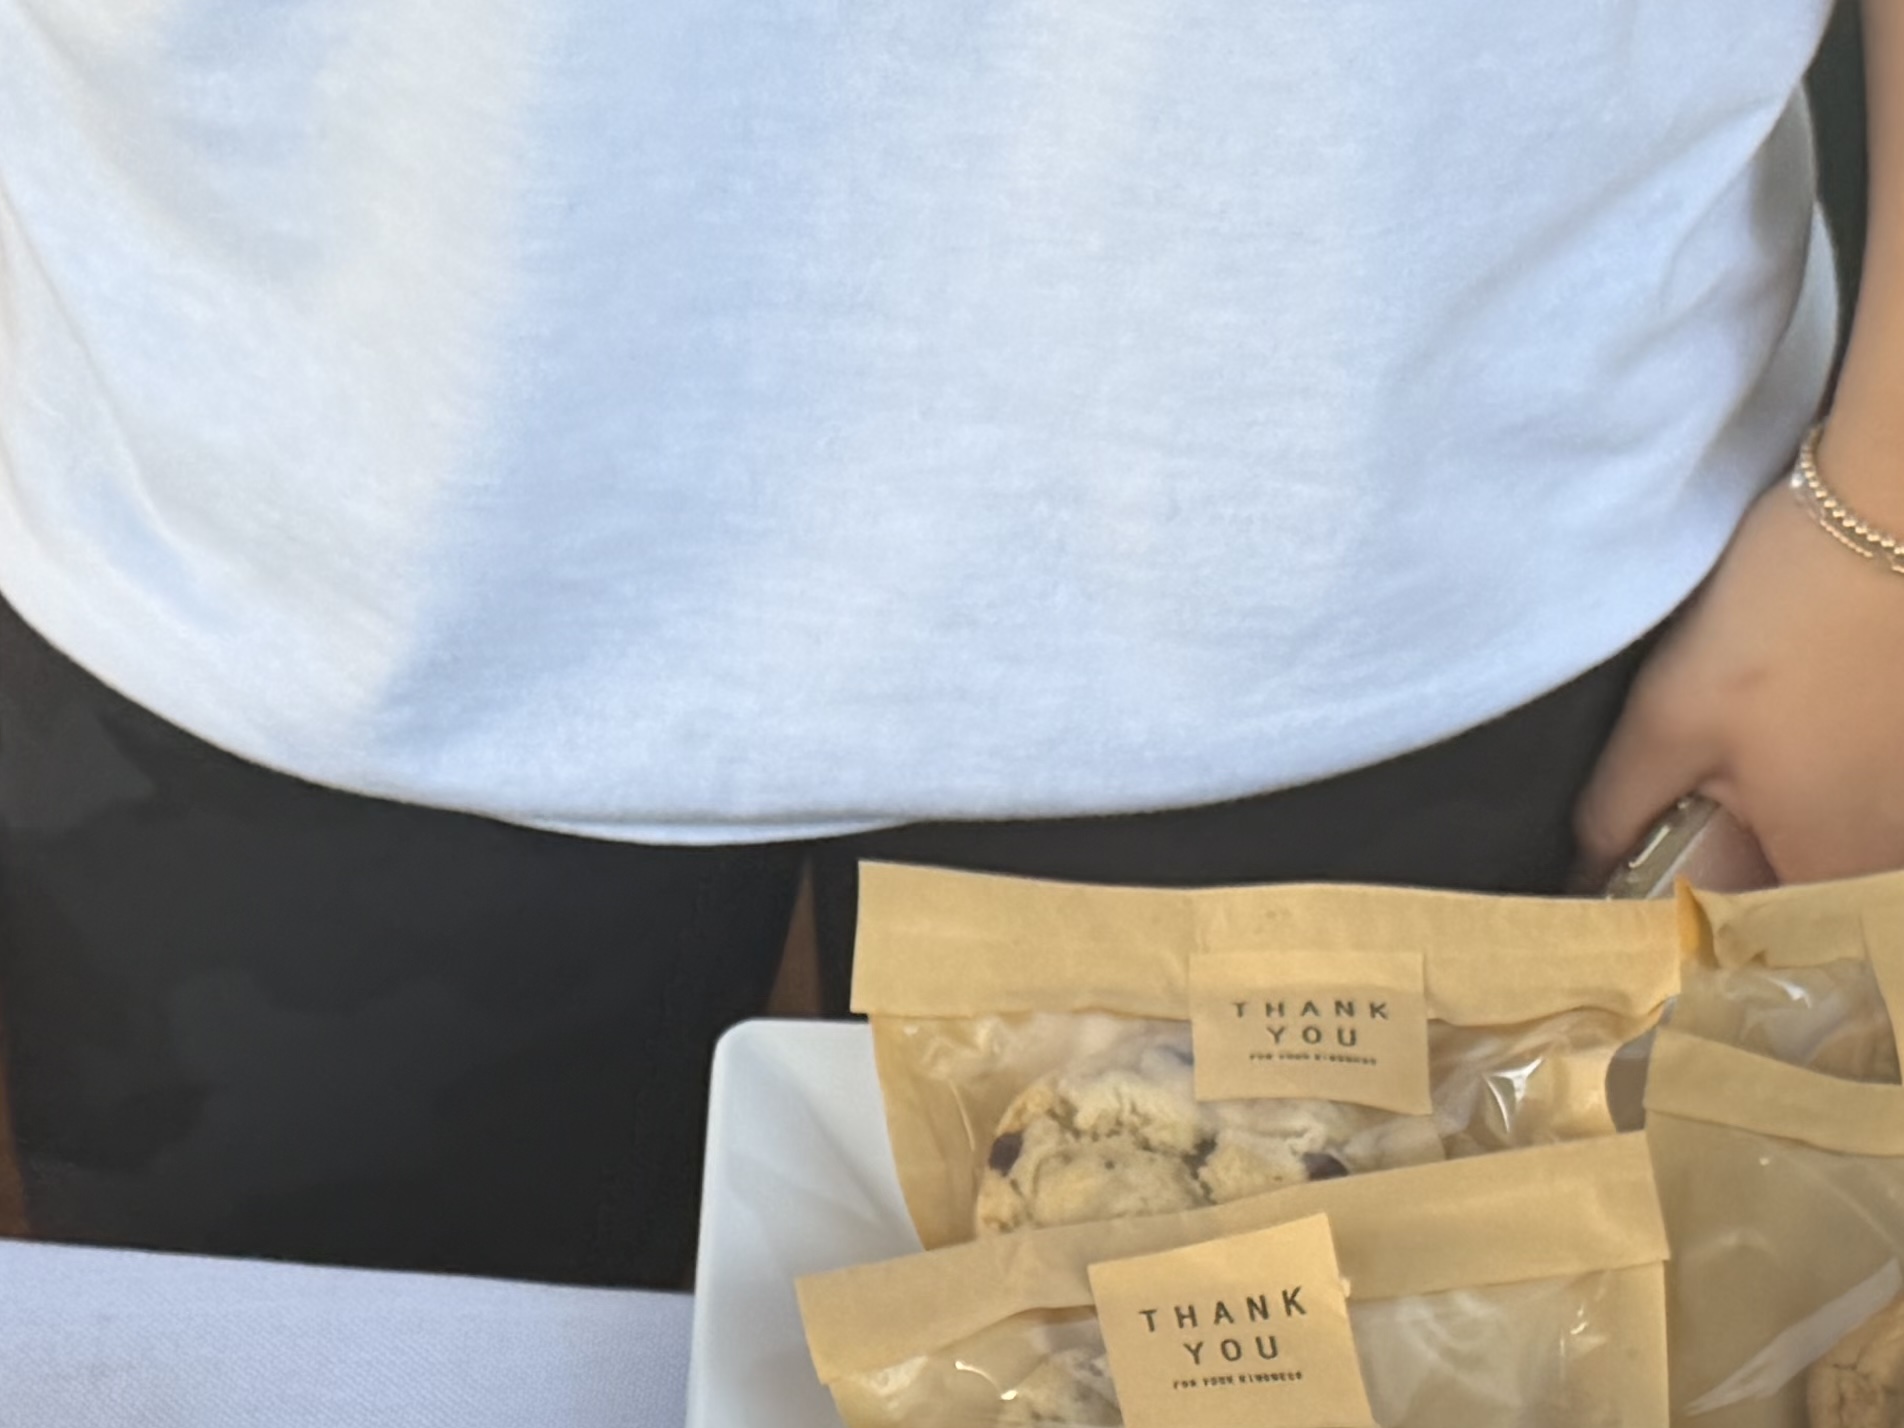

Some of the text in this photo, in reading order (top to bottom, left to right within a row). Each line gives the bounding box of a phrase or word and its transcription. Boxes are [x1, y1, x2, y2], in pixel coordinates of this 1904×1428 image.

[1233, 1000, 1388, 1019] THANK
[1266, 1025, 1358, 1047] YOU
[1138, 1286, 1307, 1333] THANK
[1183, 1335, 1279, 1366] YOU
